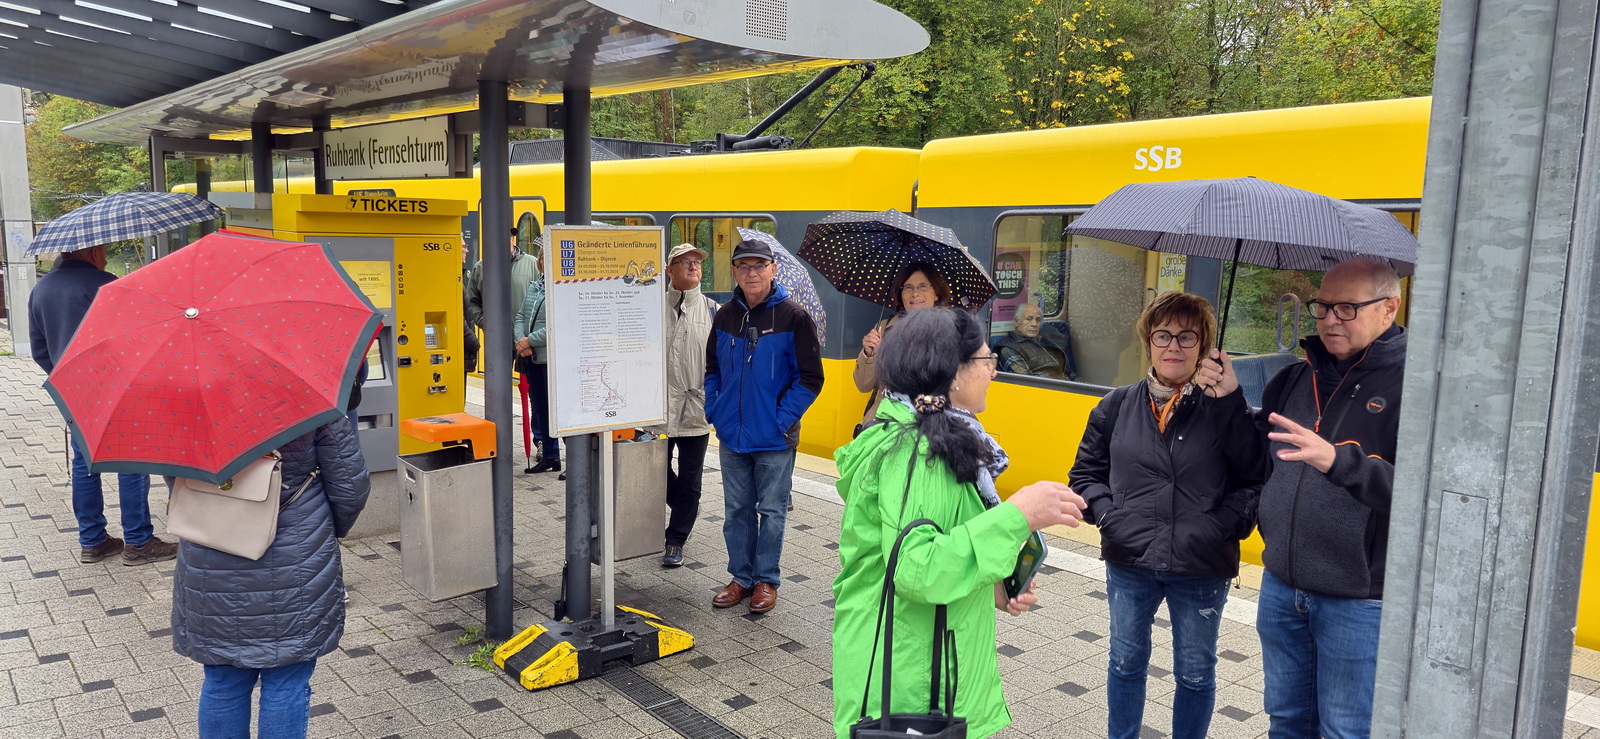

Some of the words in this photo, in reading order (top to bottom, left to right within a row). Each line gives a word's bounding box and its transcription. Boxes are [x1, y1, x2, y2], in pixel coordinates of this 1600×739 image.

[326, 141, 366, 167] Ruhbank
[368, 130, 449, 170] (Fernsehturm)
[1134, 145, 1182, 172] SSB
[360, 198, 428, 212] TICKETS
[423, 242, 440, 251] SSB
[614, 241, 657, 250] Linienführung
[997, 262, 1002, 270] U
[1004, 262, 1021, 270] CAN
[1166, 254, 1186, 268] große
[995, 270, 1022, 280] TOUCH
[1160, 266, 1183, 277] Danke.
[998, 280, 1019, 288] THIS!
